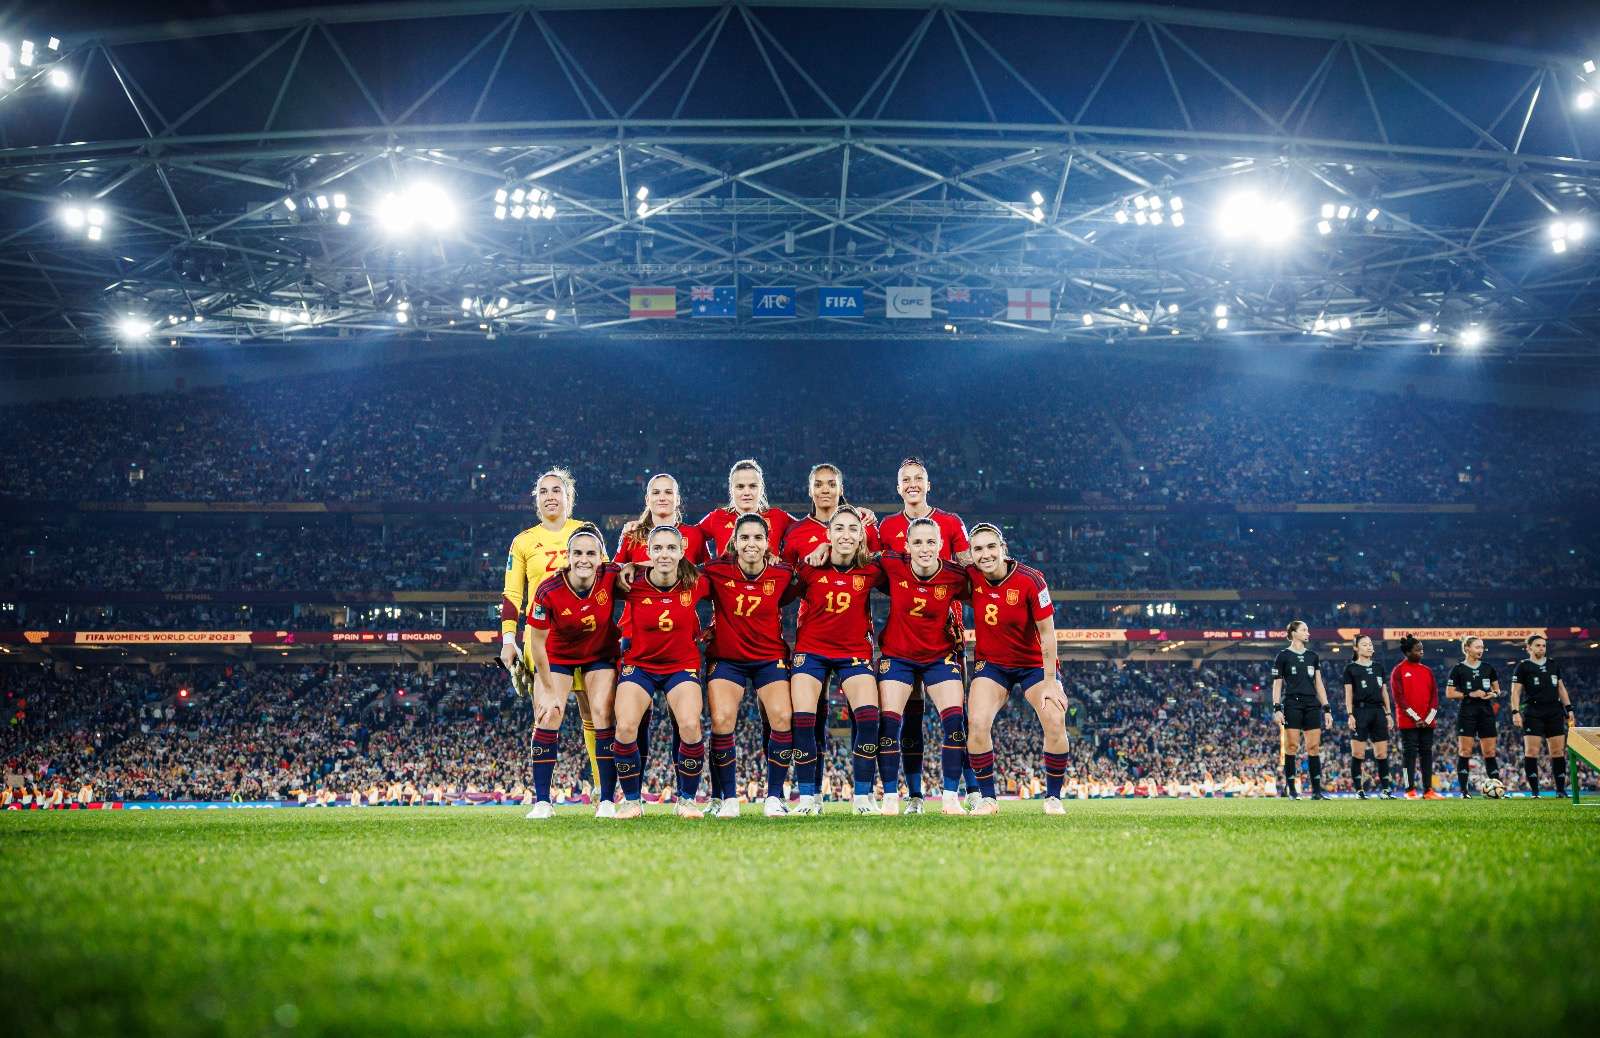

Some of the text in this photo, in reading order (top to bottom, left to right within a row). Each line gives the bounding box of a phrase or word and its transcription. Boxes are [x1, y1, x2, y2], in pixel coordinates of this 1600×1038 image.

[757, 295, 787, 309] AFC
[825, 296, 857, 308] FIFA
[734, 593, 762, 617] 17
[825, 591, 851, 613] 19
[910, 597, 927, 617] 2
[581, 614, 597, 632] 3
[658, 609, 674, 632] 6
[984, 603, 999, 625] 8
[85, 634, 236, 642] FIFA WOMEN'S WORLD CUP 2023
